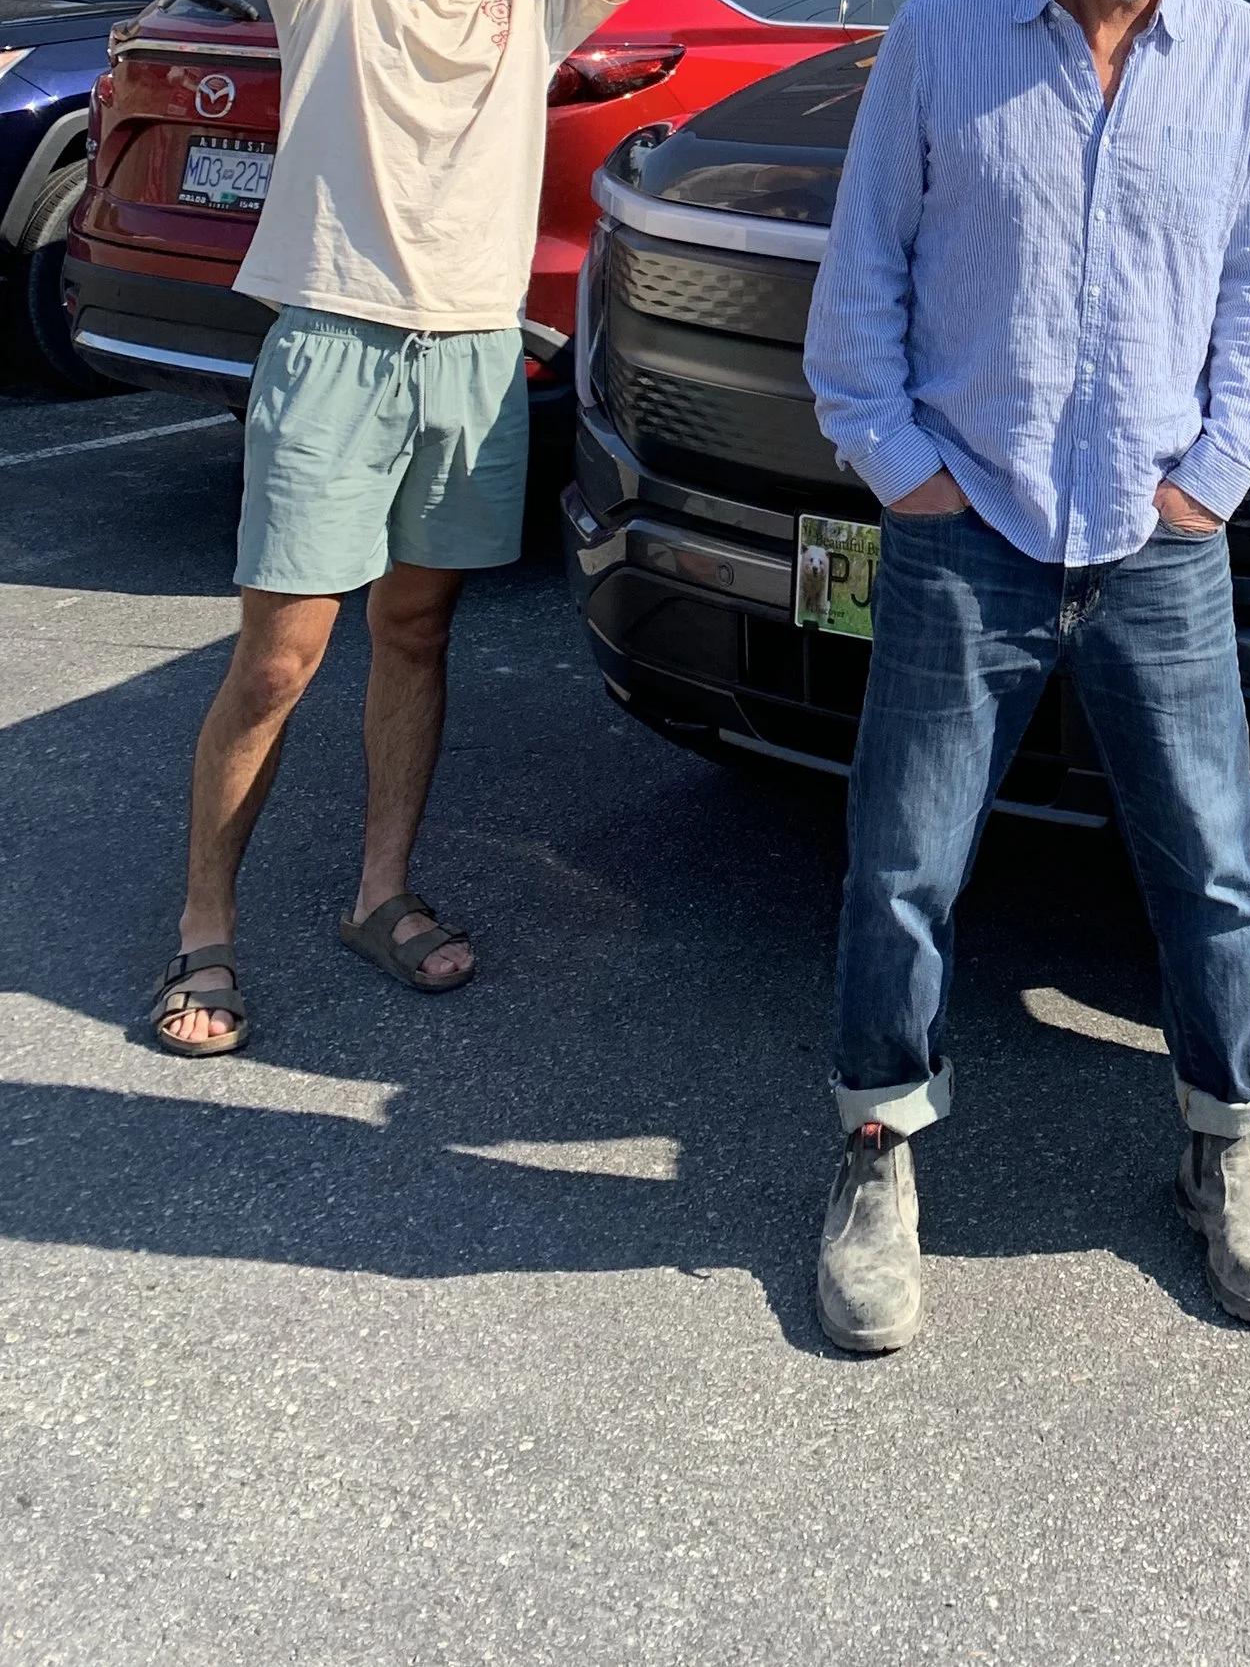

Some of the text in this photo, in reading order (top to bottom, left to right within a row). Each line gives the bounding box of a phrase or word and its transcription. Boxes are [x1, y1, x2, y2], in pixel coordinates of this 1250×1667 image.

[184, 154, 271, 194] MD3 22H
[827, 552, 879, 608] PJ
